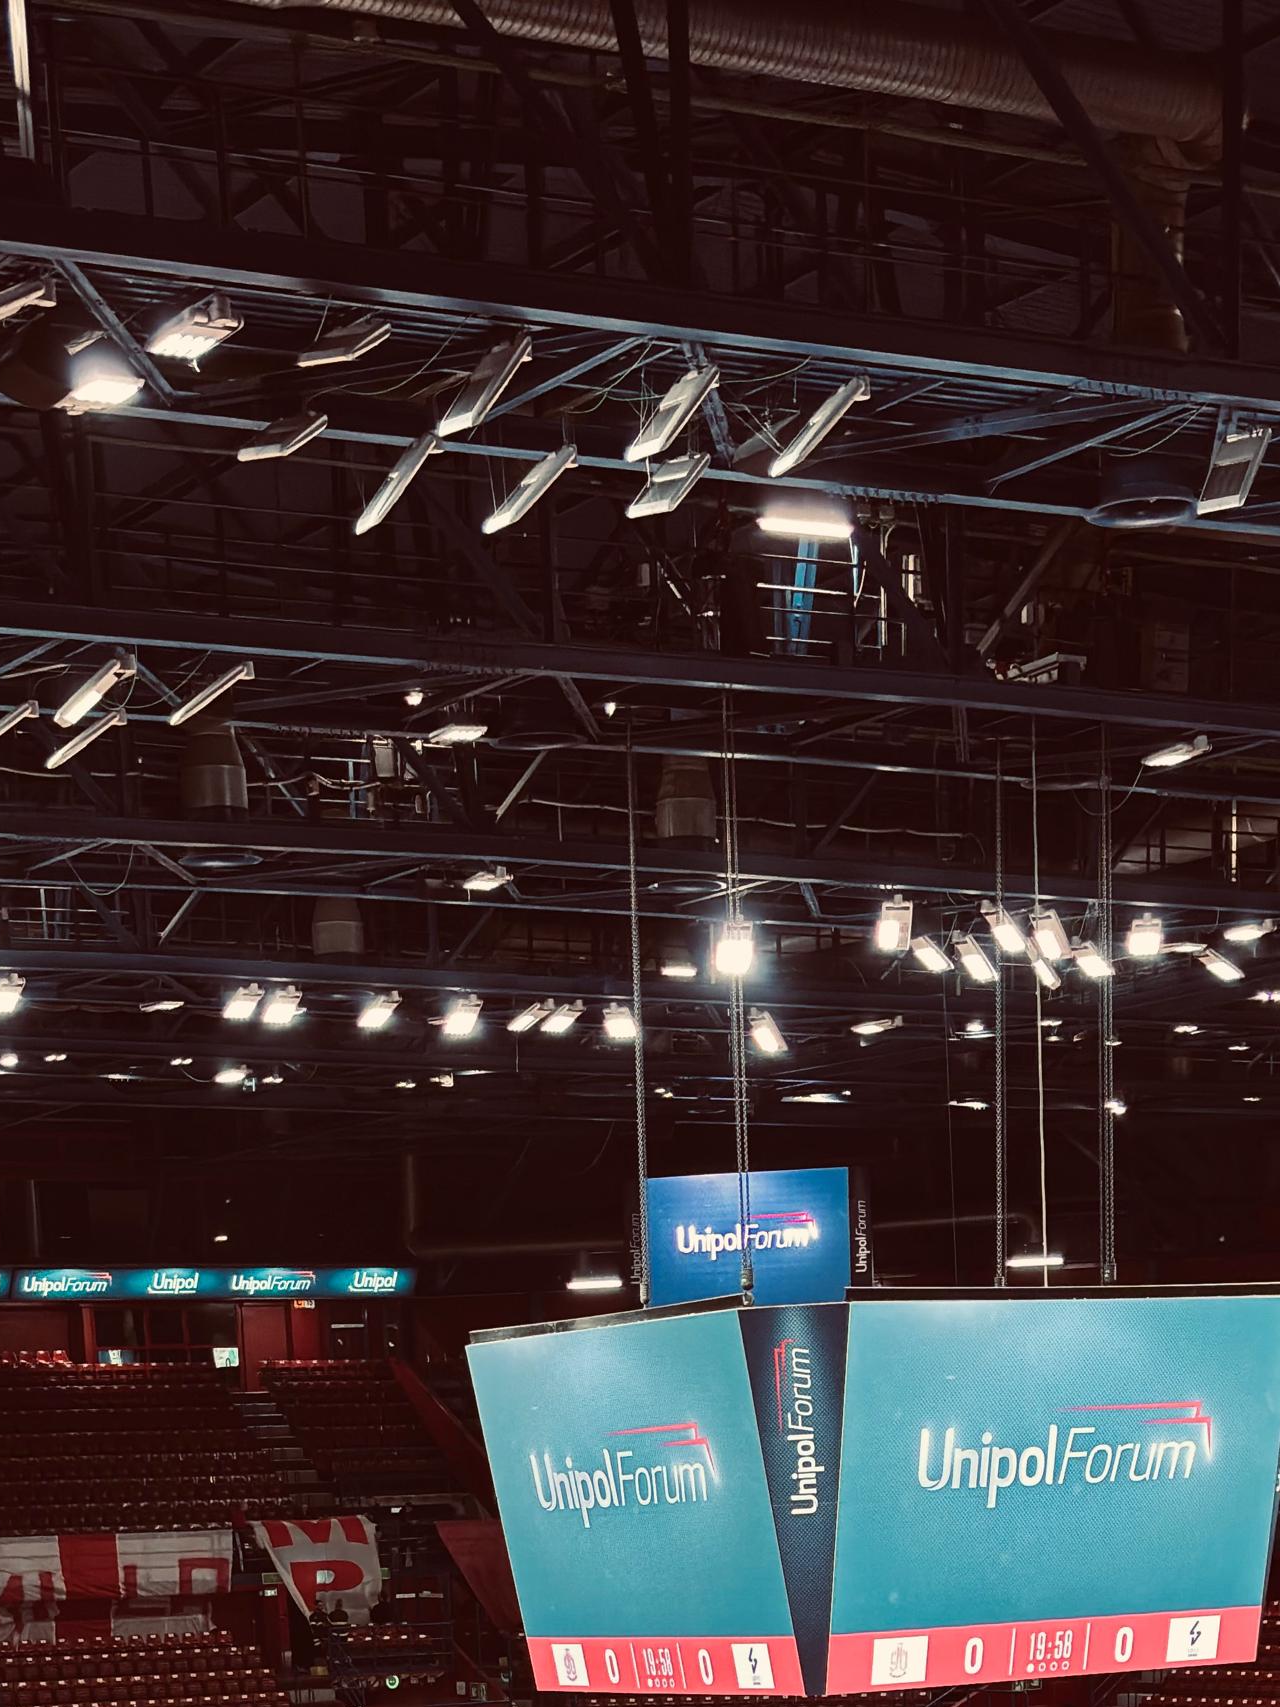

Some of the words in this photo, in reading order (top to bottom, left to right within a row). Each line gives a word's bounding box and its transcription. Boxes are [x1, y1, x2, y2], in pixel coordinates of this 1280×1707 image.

[676, 1223, 811, 1260] UnipolForum
[855, 1200, 867, 1273] UnipolForum
[23, 1276, 108, 1297] UnipolForum
[152, 1272, 199, 1294] Unipol
[231, 1274, 312, 1295] UnipolForum
[353, 1271, 396, 1293] Unipol
[790, 1344, 821, 1516] UnipolForum
[916, 1422, 1198, 1509] UnipolForum
[529, 1447, 708, 1528] UnipolForum
[642, 1647, 674, 1677] 19:58
[964, 1636, 983, 1675] 0
[1029, 1629, 1073, 1660] 19:58
[1115, 1626, 1134, 1663] 0
[604, 1648, 620, 1684] 0
[698, 1648, 714, 1686] 0
